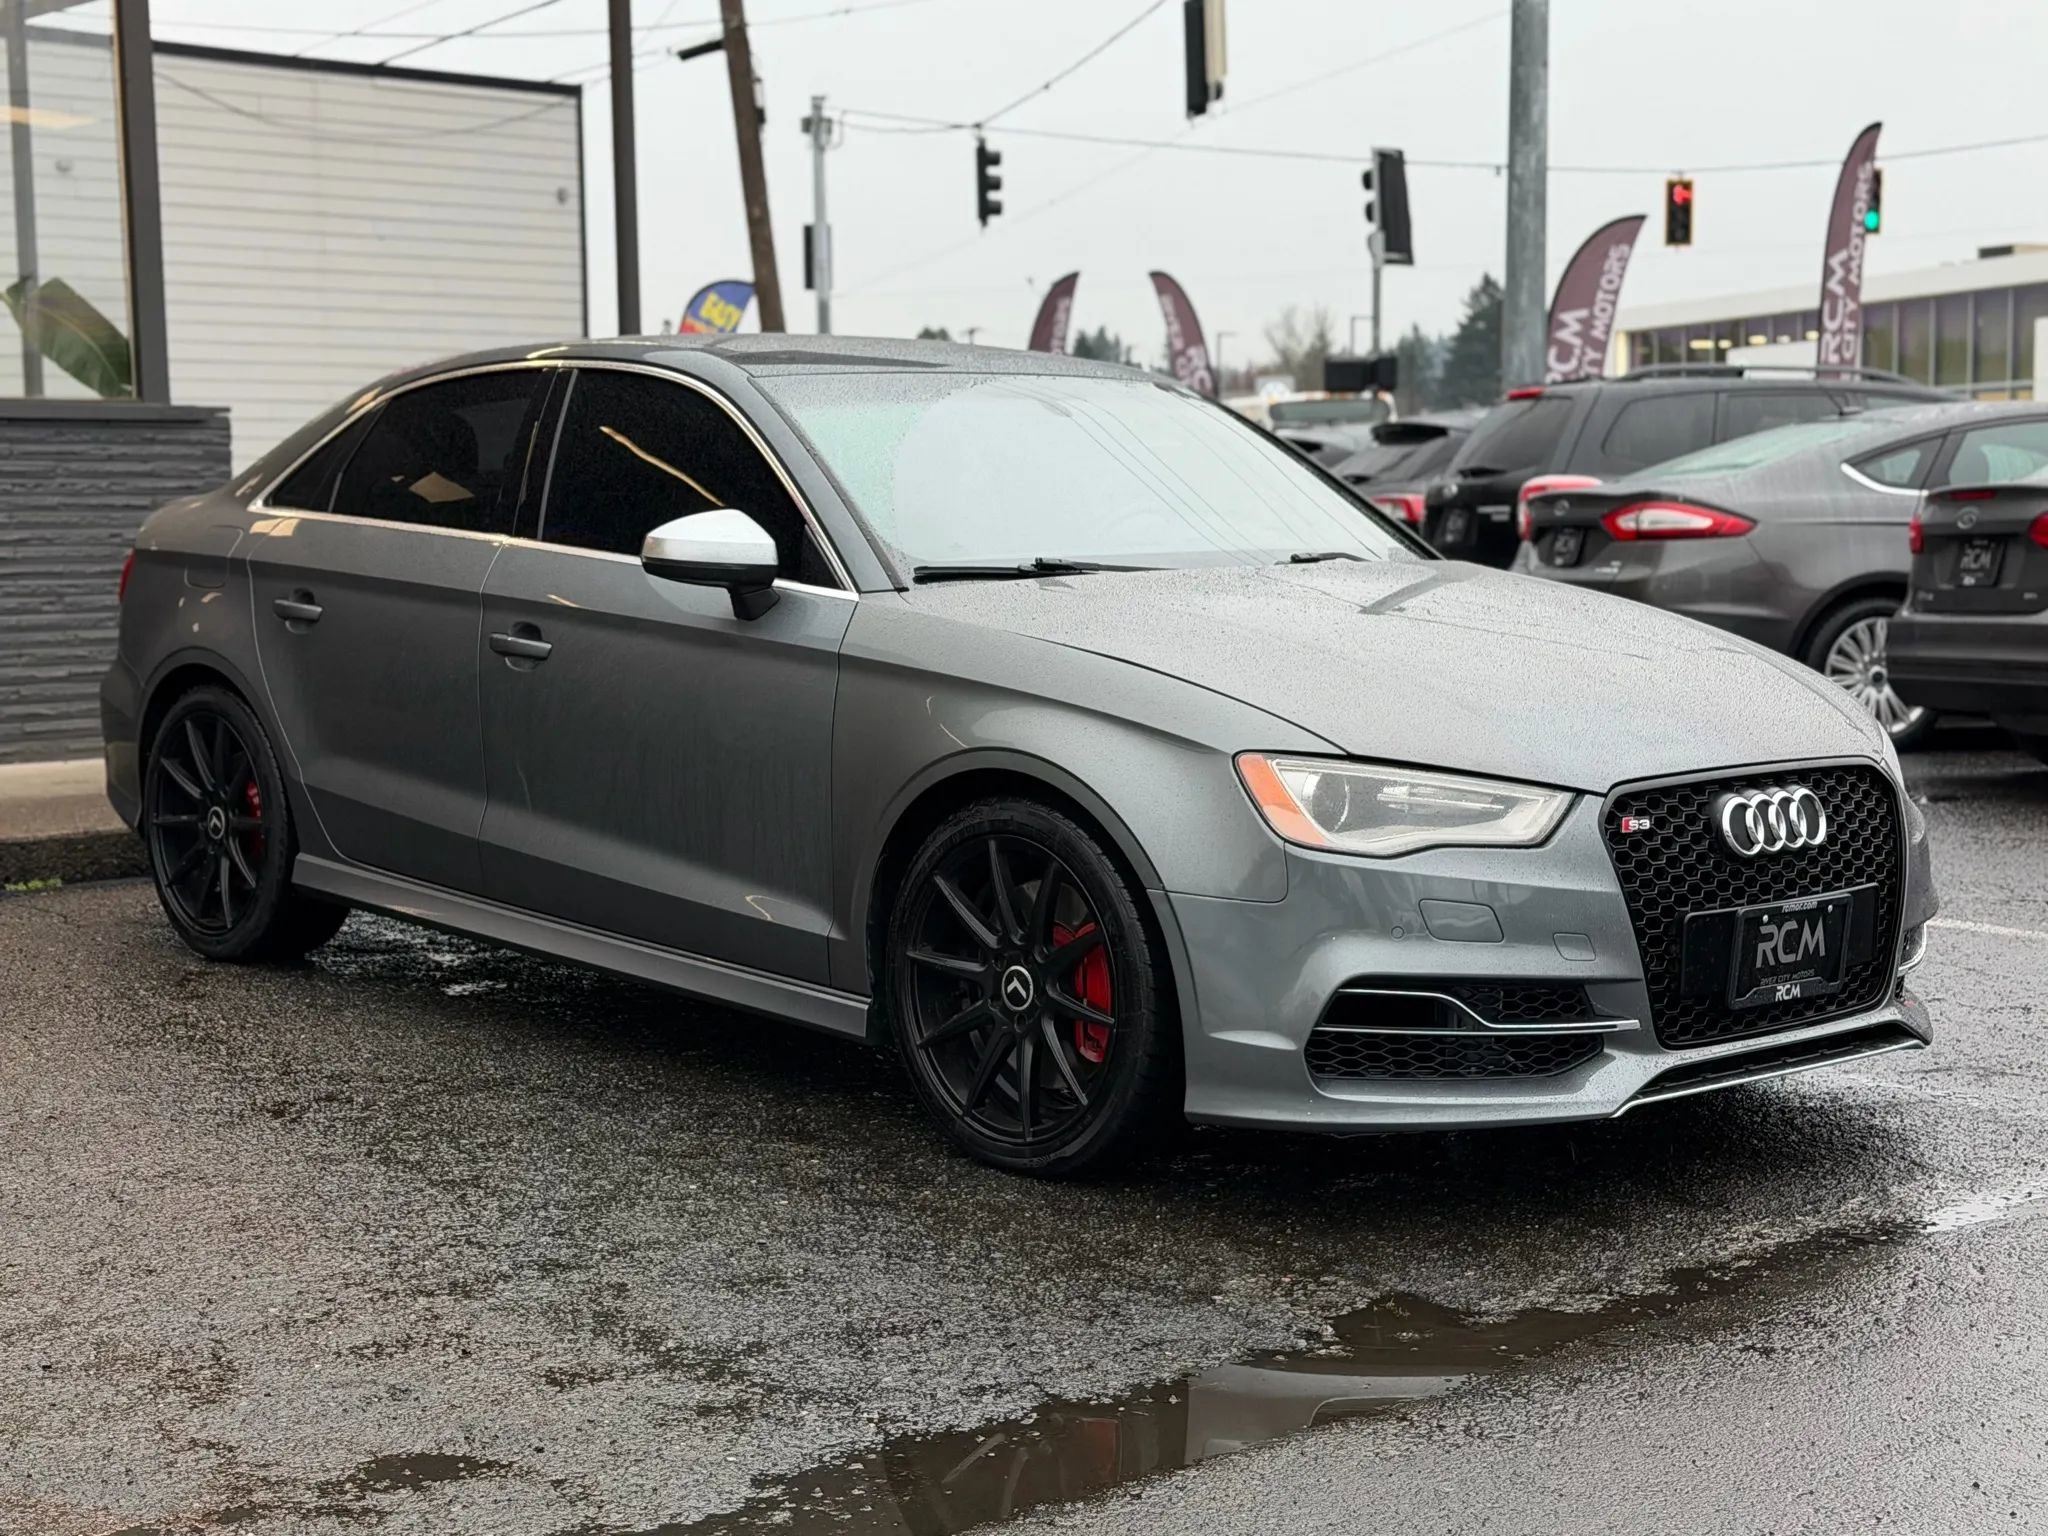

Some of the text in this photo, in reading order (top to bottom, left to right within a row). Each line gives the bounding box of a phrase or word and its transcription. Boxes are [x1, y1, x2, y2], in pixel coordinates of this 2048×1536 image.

[1589, 243, 1631, 341] MOTORS
[1842, 161, 1873, 360] CITY MOTORS
[1821, 249, 1848, 363] RCM
[1628, 819, 1650, 830] S3
[1756, 916, 1825, 968] RCM
[1775, 983, 1800, 1002] RCM
